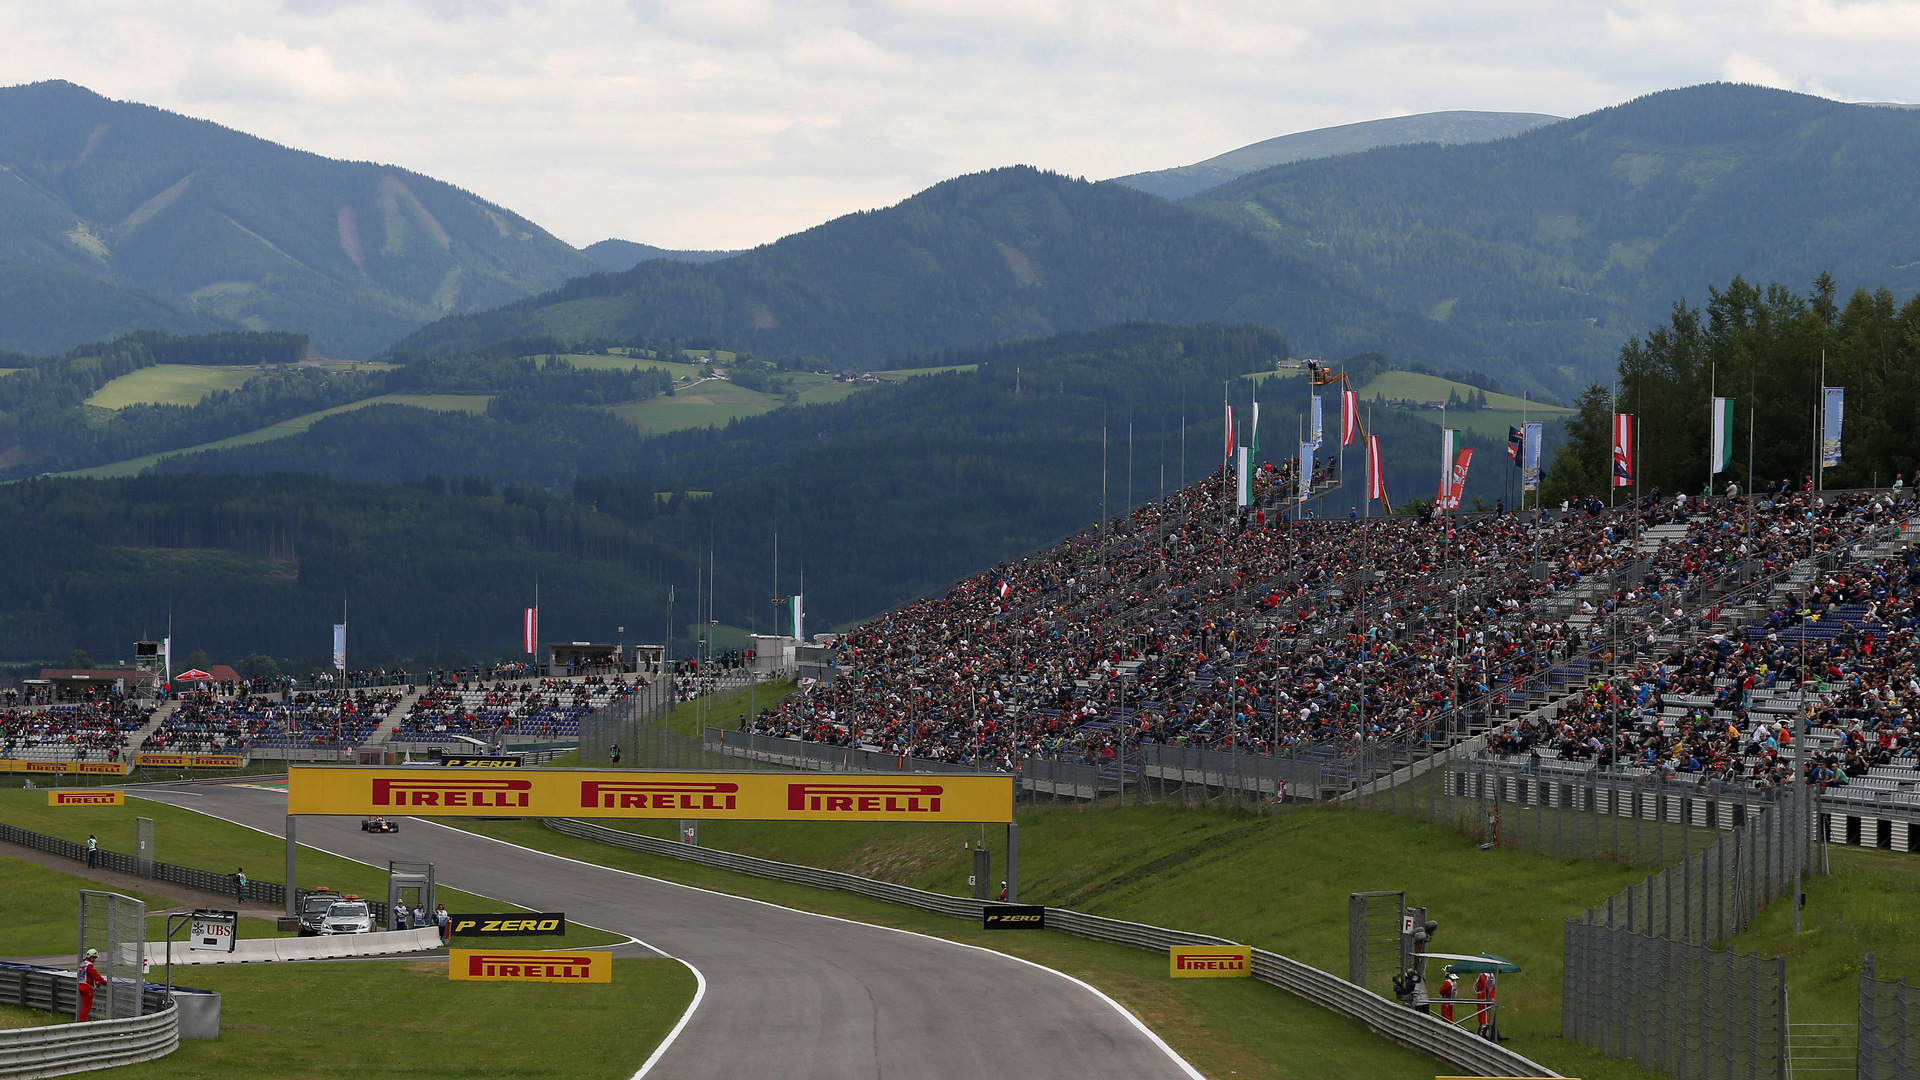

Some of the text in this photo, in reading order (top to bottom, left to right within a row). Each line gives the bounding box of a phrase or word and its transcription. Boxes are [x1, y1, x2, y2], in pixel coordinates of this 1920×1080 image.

[142, 755, 183, 764] PIRELLI
[195, 756, 237, 765] PIRELLI
[26, 762, 67, 771] PIRELLI
[80, 763, 121, 773] PIRELLI
[57, 792, 116, 804] PIRELLI
[373, 779, 531, 807] PIRELLI
[581, 781, 739, 809] PIRELLI
[788, 783, 944, 812] PIRELLI
[206, 924, 231, 937] UBS
[455, 920, 559, 931] P ZERO
[469, 956, 591, 978] PIRELLI
[1176, 954, 1245, 970] PIRELLI
